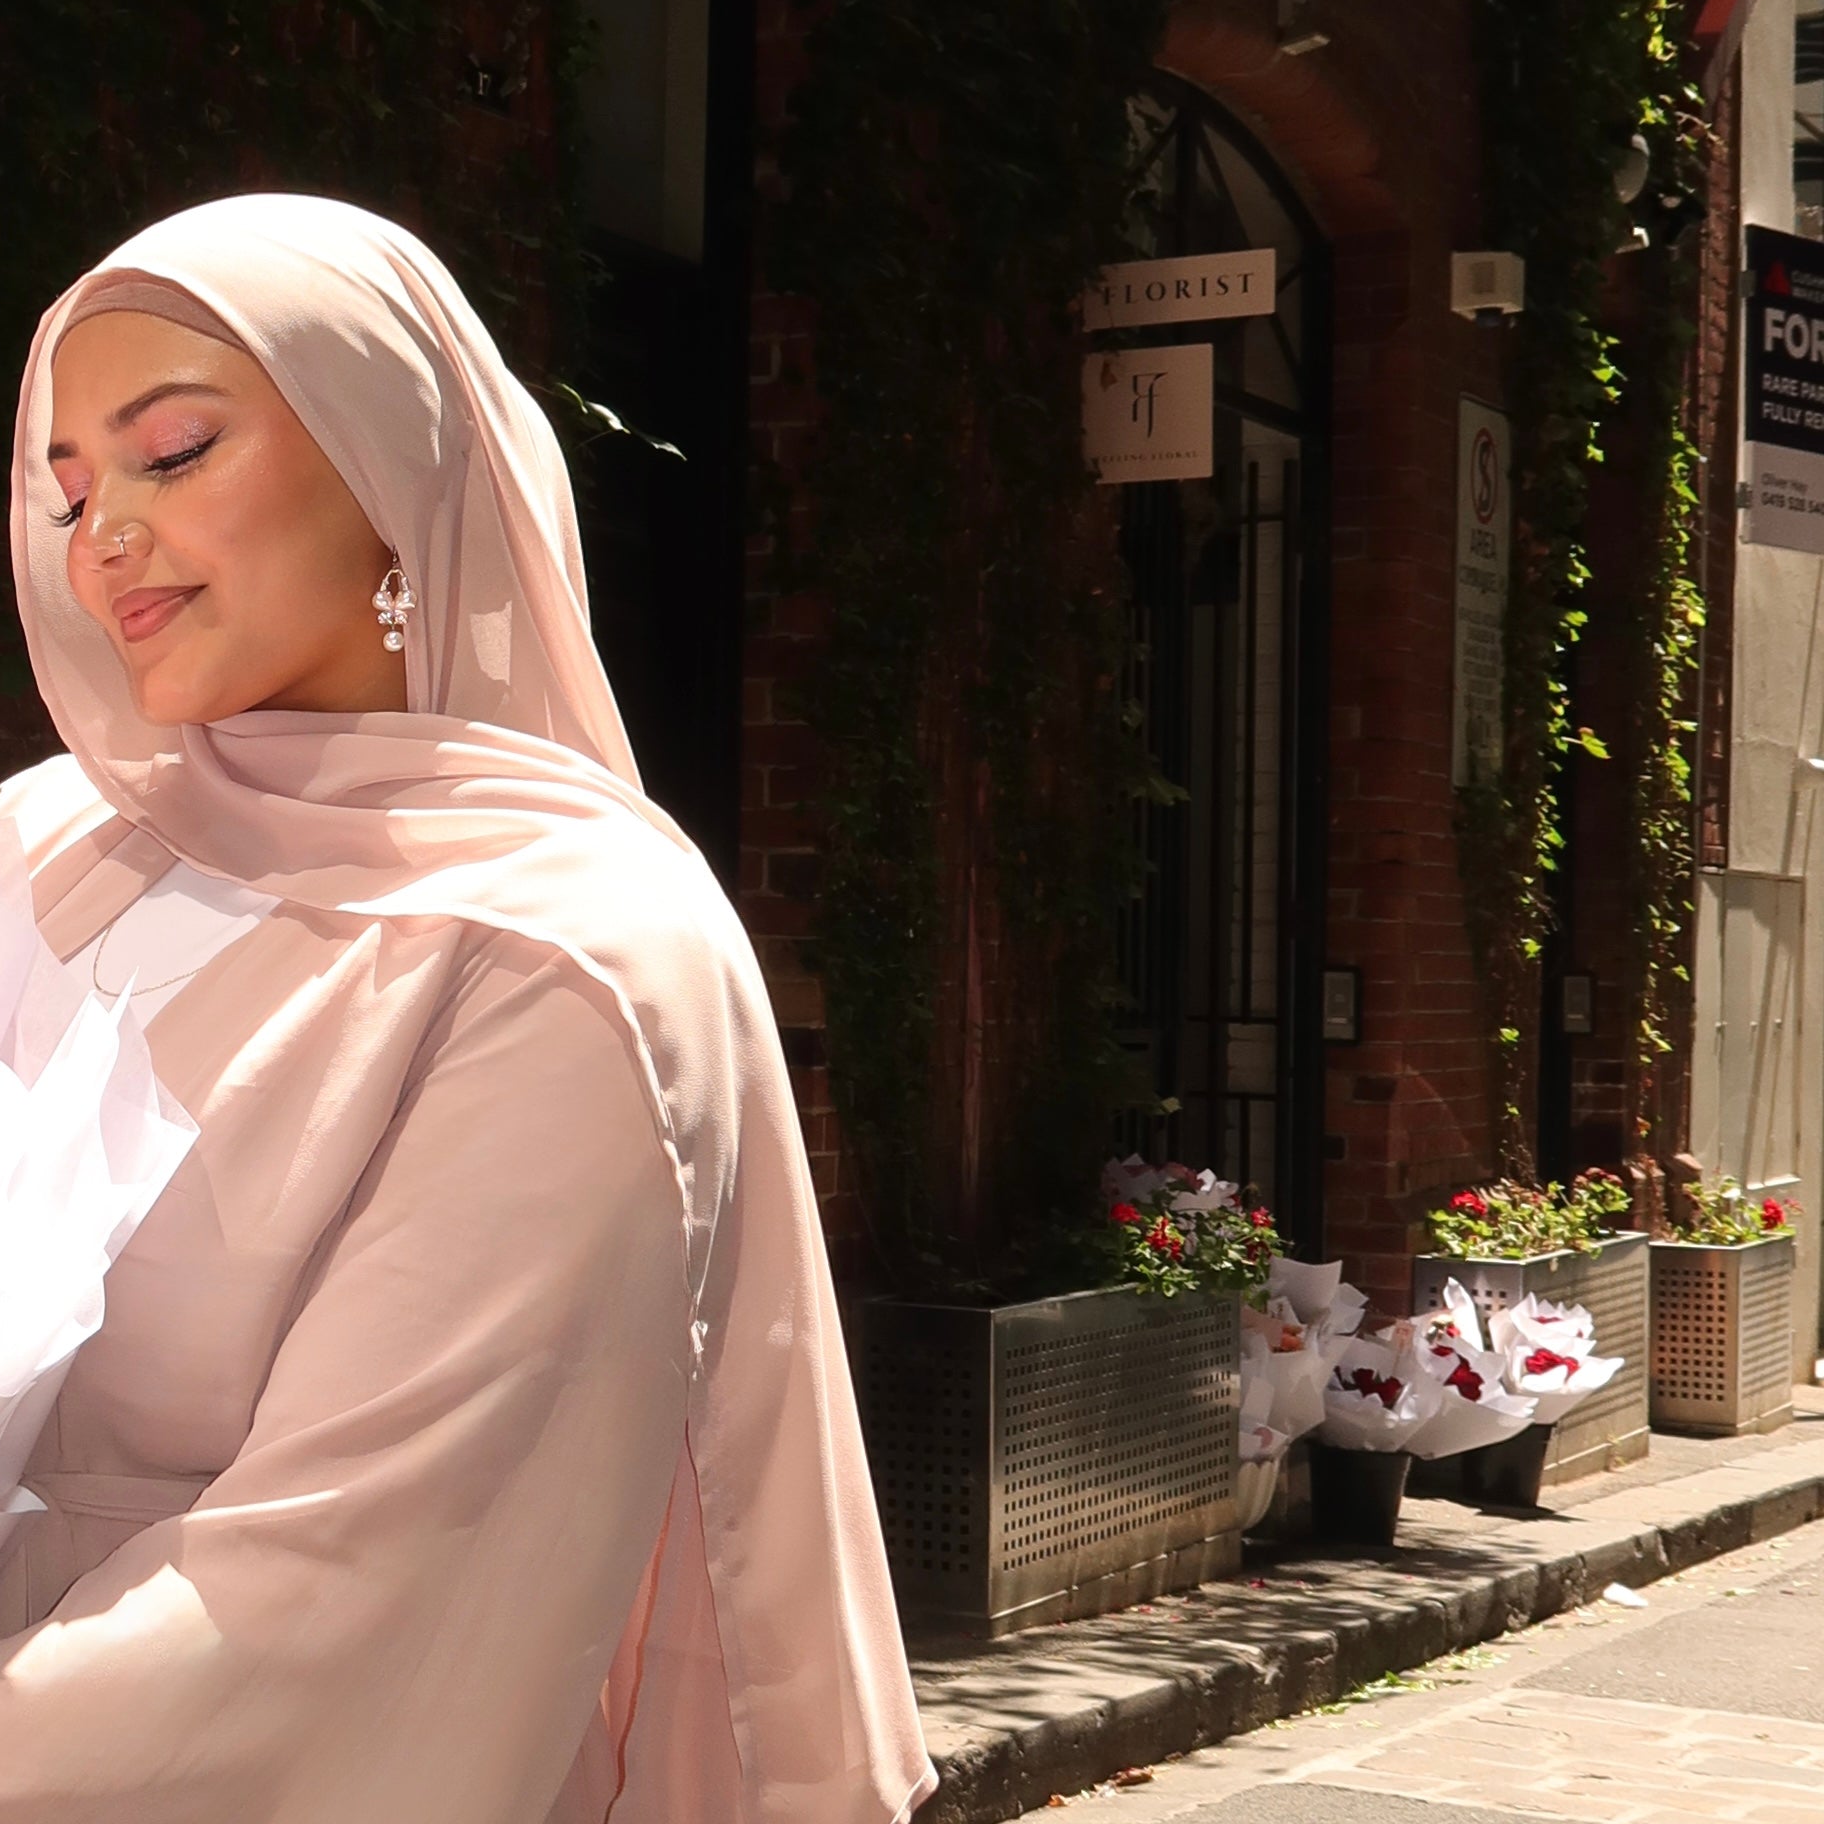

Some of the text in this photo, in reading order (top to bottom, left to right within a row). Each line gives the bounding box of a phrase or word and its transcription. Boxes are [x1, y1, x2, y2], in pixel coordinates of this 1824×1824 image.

[1102, 272, 1253, 306] FLORIST
[1763, 307, 1824, 363] FOR
[1762, 373, 1799, 397] RARE
[1762, 401, 1824, 431] FULLY RE
